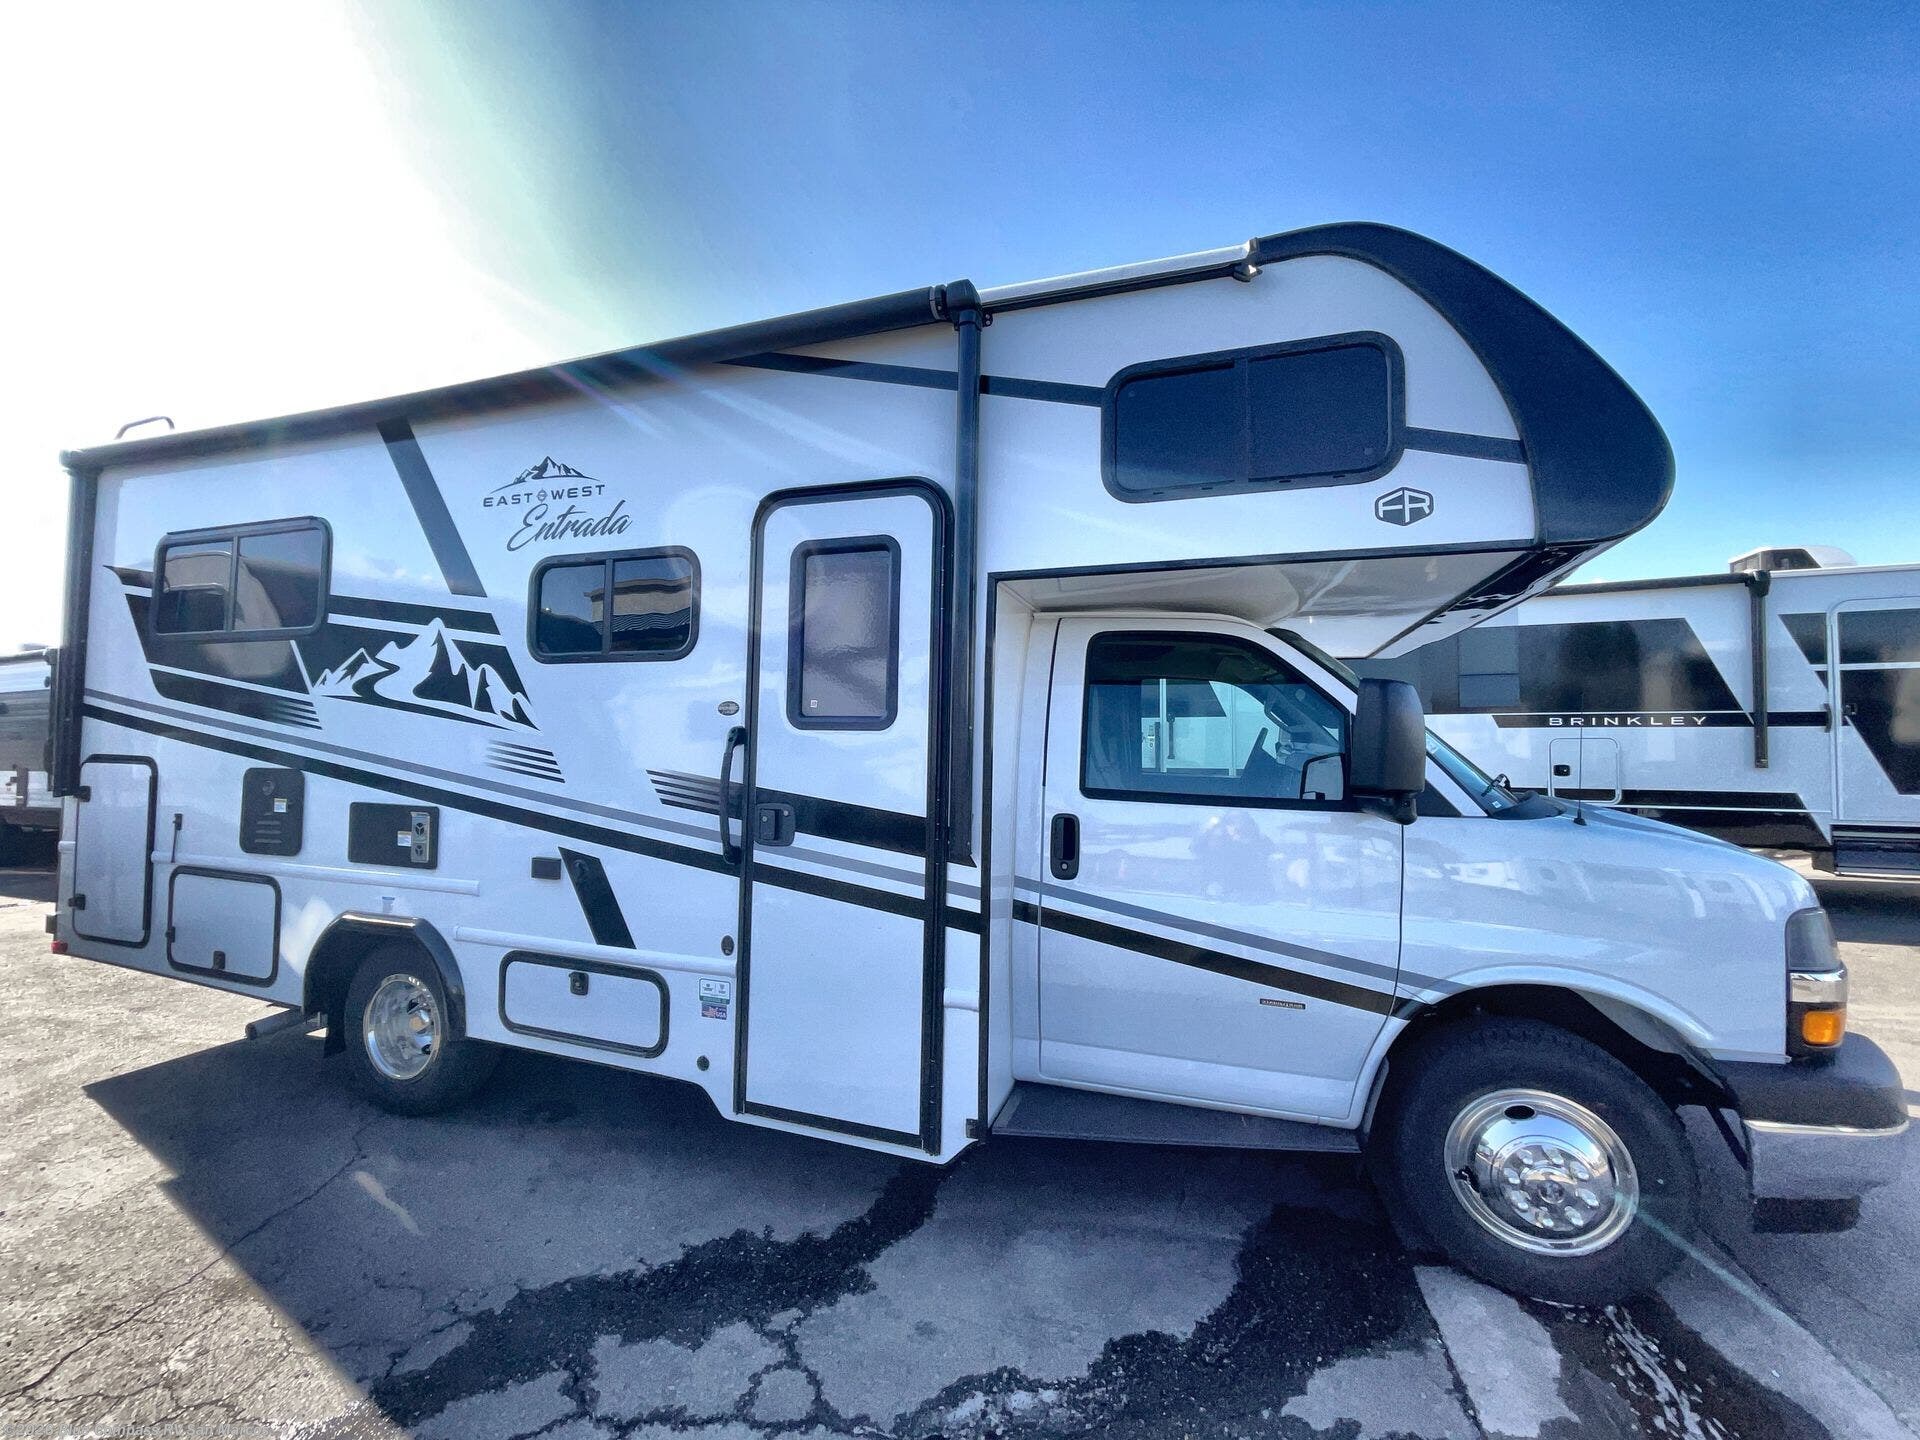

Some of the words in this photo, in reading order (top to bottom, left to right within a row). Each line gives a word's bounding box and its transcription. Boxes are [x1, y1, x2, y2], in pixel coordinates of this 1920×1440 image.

[483, 493, 533, 507] EAST
[551, 484, 605, 501] WEST
[507, 500, 632, 551] Entrada
[1549, 716, 1707, 726] BRINKLEY
